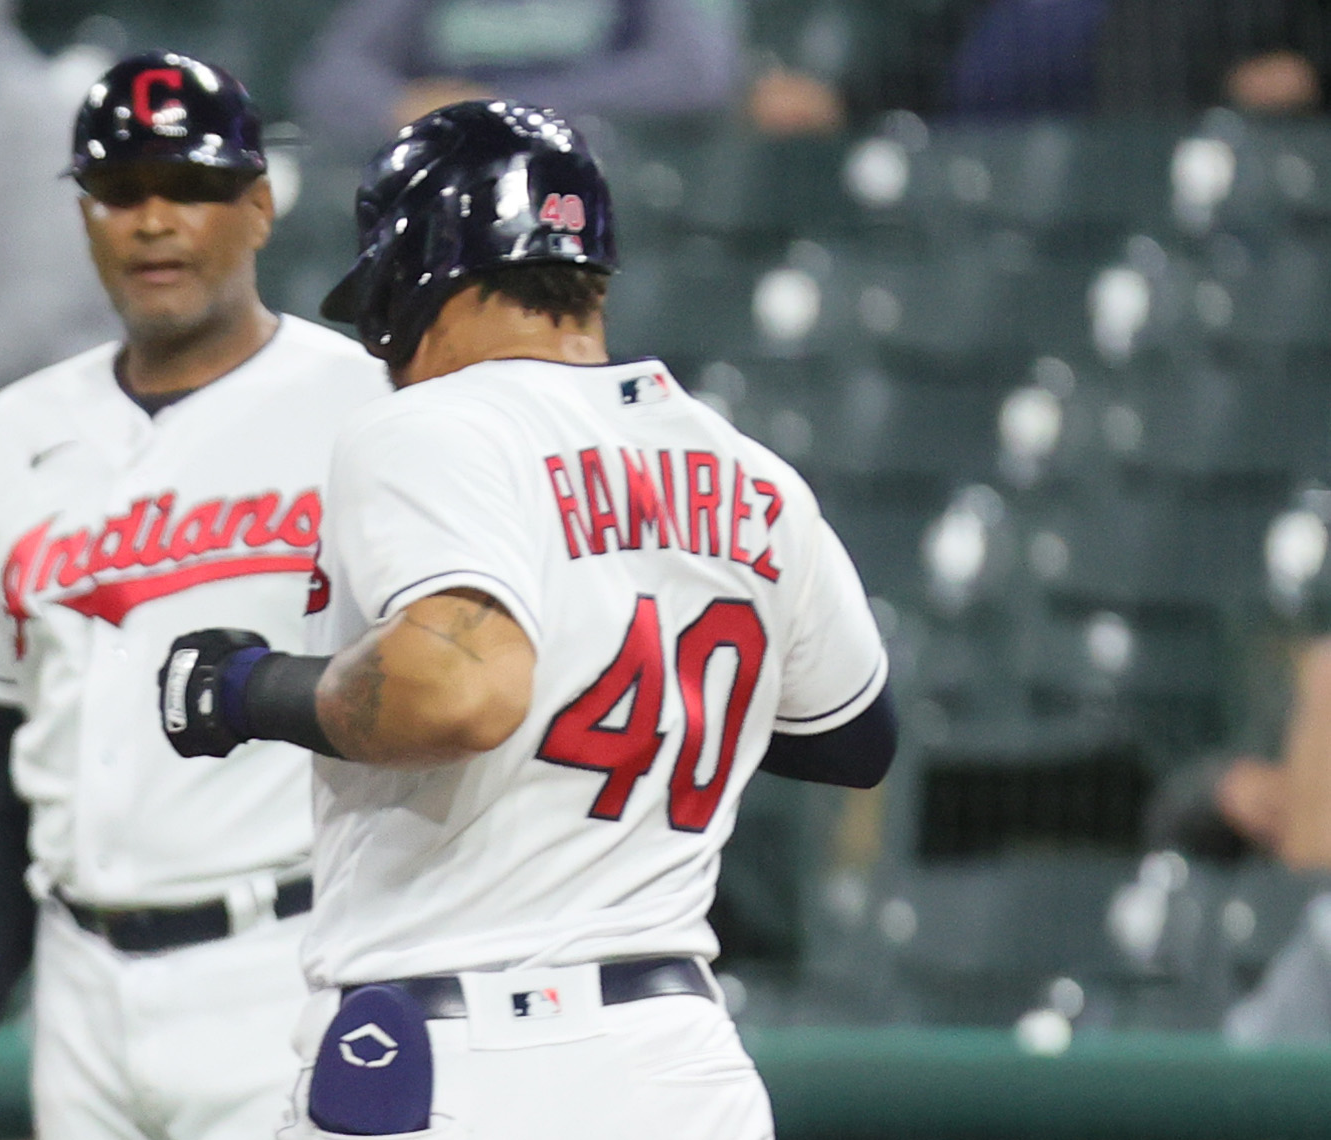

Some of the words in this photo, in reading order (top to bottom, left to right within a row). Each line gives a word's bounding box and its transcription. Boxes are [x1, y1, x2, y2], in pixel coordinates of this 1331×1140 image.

[132, 67, 184, 129] C
[539, 192, 587, 233] 40
[543, 446, 784, 583] RAMIREZ
[535, 592, 768, 833] 40
